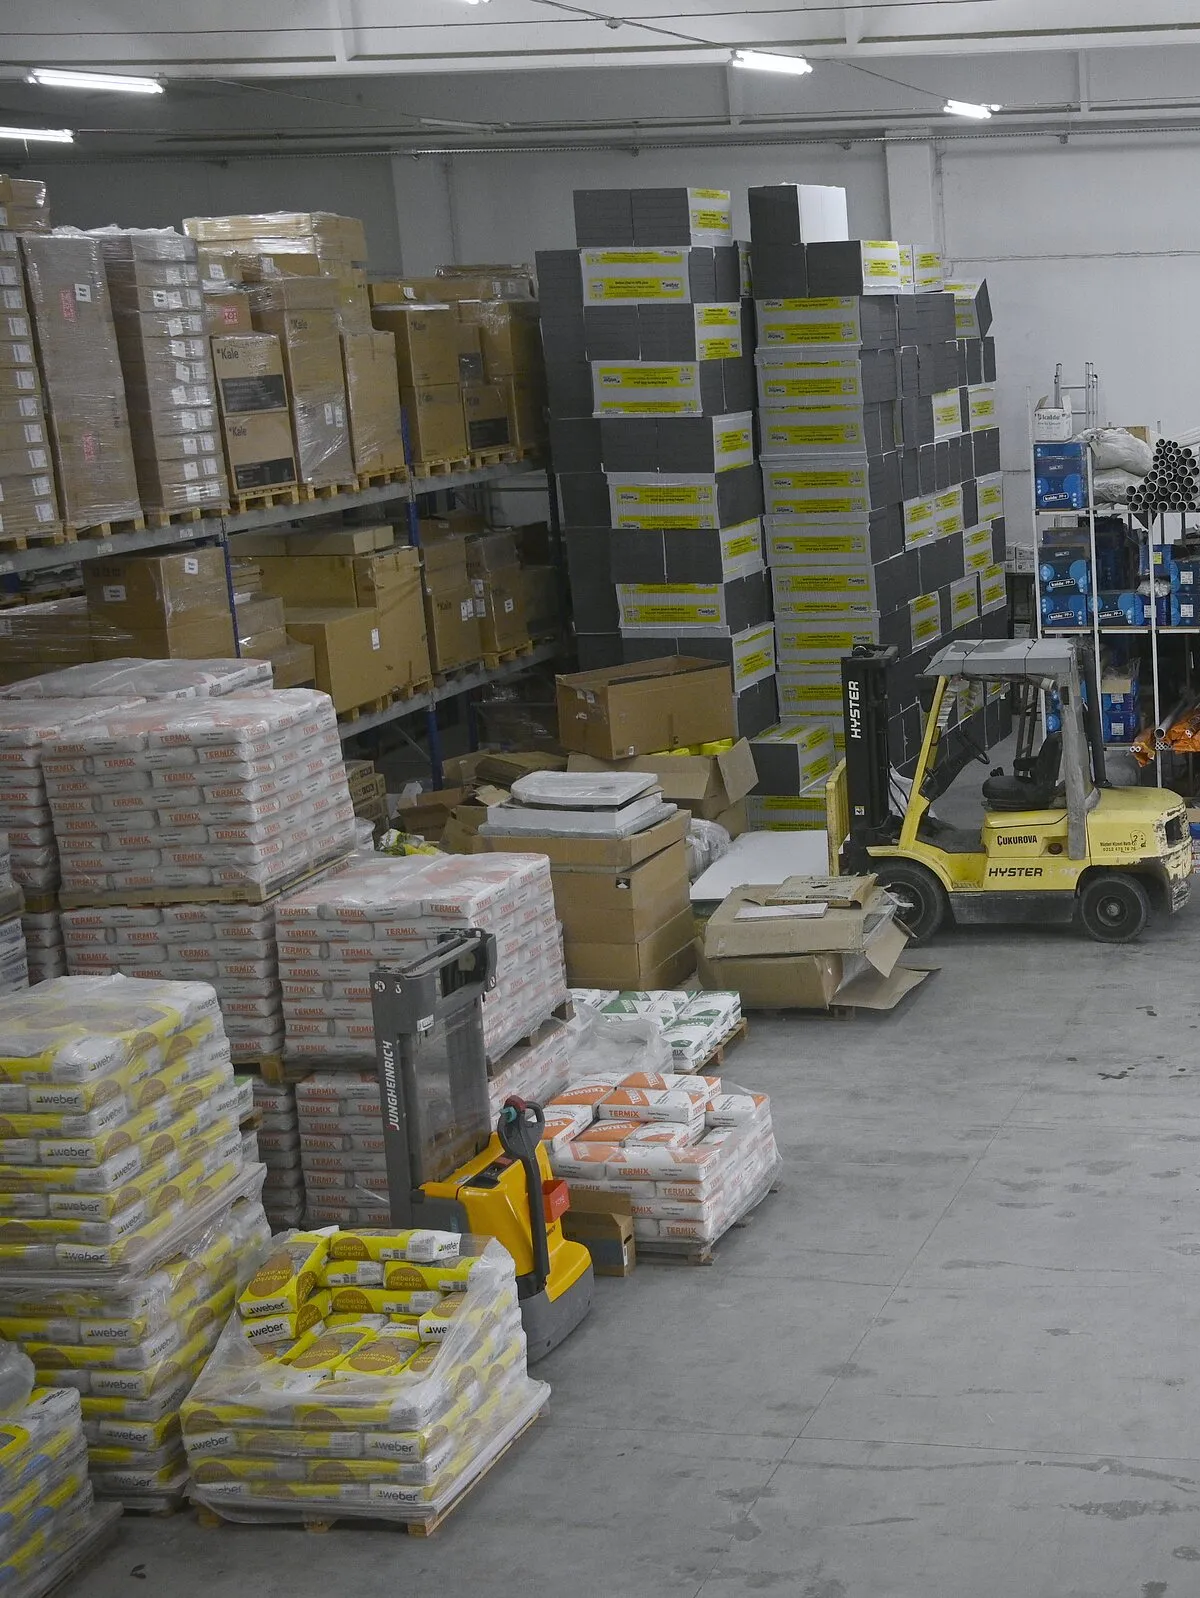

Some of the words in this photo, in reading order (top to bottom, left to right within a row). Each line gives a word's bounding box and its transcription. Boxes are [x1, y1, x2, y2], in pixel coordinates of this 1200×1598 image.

[221, 348, 239, 360] Kale
[232, 426, 247, 437] Kale
[848, 680, 861, 739] HYSTER
[160, 734, 192, 742] TERMIX
[55, 744, 86, 752] TERMIX
[204, 749, 237, 759] TERMIX
[104, 758, 136, 767] TERMIX
[44, 765, 77, 773] TERMIX
[163, 773, 196, 781] TERMIX
[56, 783, 89, 791] TERMIX
[212, 788, 244, 798] TERMIX
[54, 802, 86, 810] TERMIX
[113, 798, 144, 806] TERMIX
[169, 813, 201, 822] TERMIX
[66, 821, 98, 829] TERMIX
[8, 832, 30, 841] RMIX
[215, 830, 248, 839] TERMIX
[62, 840, 95, 849] TERMIX
[119, 836, 151, 845] TERMIX
[173, 854, 204, 862] TERMIX
[71, 859, 103, 867] TERMIX
[988, 867, 1043, 877] HYSTER
[279, 908, 311, 916] TERMIX
[335, 908, 366, 917] TERMIX
[430, 904, 462, 913] TERMIX
[71, 916, 104, 925] TERMIX
[174, 911, 207, 921] TERMIX
[67, 931, 98, 941] TERMIX
[127, 931, 159, 941] TERMIX
[222, 927, 254, 936] TERMIX
[286, 929, 318, 938] TERMIX
[385, 928, 417, 936] TERMIX
[179, 949, 210, 958] TERMIX
[281, 947, 312, 956] TERMIX
[341, 948, 373, 956] TERMIX
[77, 952, 109, 961] TERMIX
[132, 969, 164, 977] TERMIX
[225, 965, 257, 974] TERMIX
[288, 968, 320, 977] TERMIX
[284, 986, 315, 994] TERMIX
[227, 1003, 257, 1011] TERMIX
[293, 1007, 325, 1016] TERMIX
[289, 1024, 320, 1033] TERMIX
[296, 1044, 327, 1052] TERMIX
[382, 1040, 400, 1132] JUNGHEINRICH
[41, 1094, 79, 1105] weber
[609, 1110, 641, 1118] TERMIX
[52, 1147, 90, 1158] weber
[618, 1168, 651, 1176] TERMIX
[663, 1188, 696, 1196] TERMIX
[631, 1206, 653, 1214] RMIX
[253, 1301, 285, 1314] weber
[92, 1328, 128, 1338] weber
[253, 1323, 284, 1336] weber
[103, 1379, 139, 1390] weber
[111, 1430, 148, 1442] weber
[197, 1435, 229, 1449] weber
[379, 1441, 413, 1453] weber
[383, 1490, 418, 1502] weber
